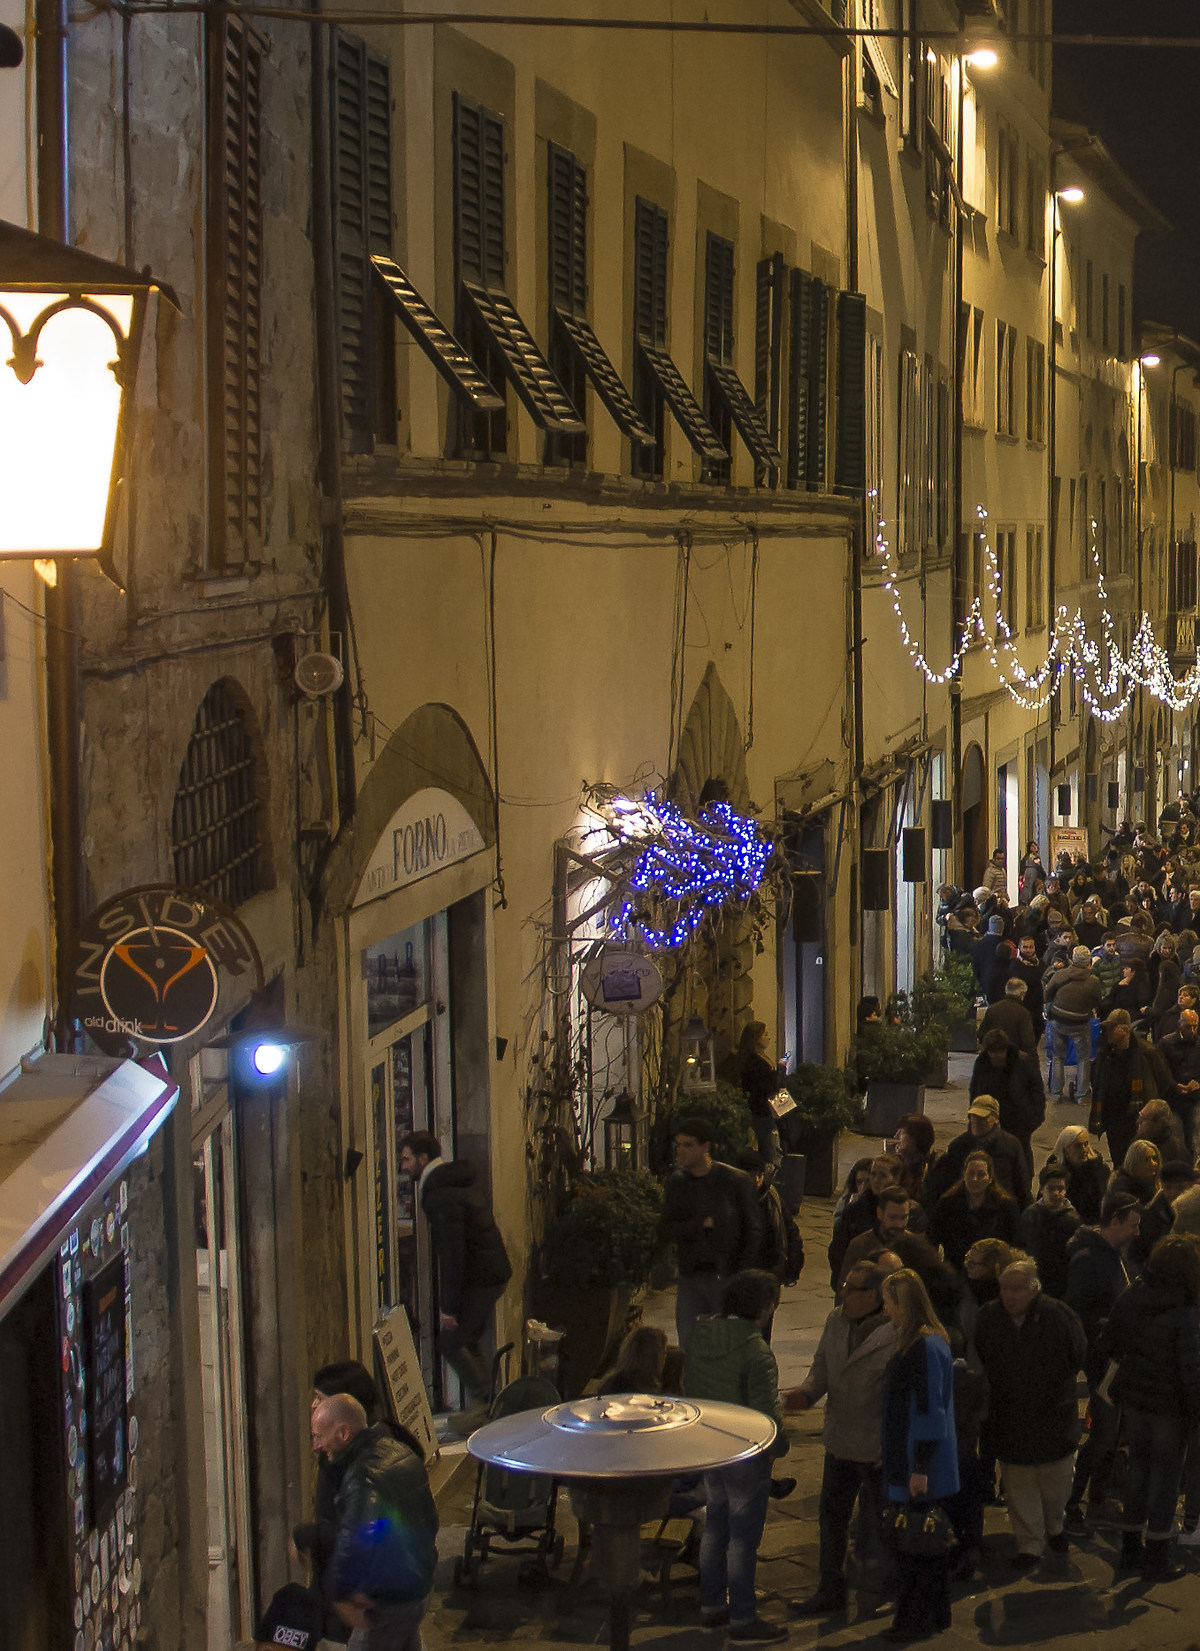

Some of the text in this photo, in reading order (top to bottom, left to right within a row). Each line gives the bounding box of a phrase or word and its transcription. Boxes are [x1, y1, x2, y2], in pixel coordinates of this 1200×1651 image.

[392, 813, 446, 882] FORNO
[84, 1016, 143, 1034] old drink
[275, 1627, 309, 1648] OBEY
